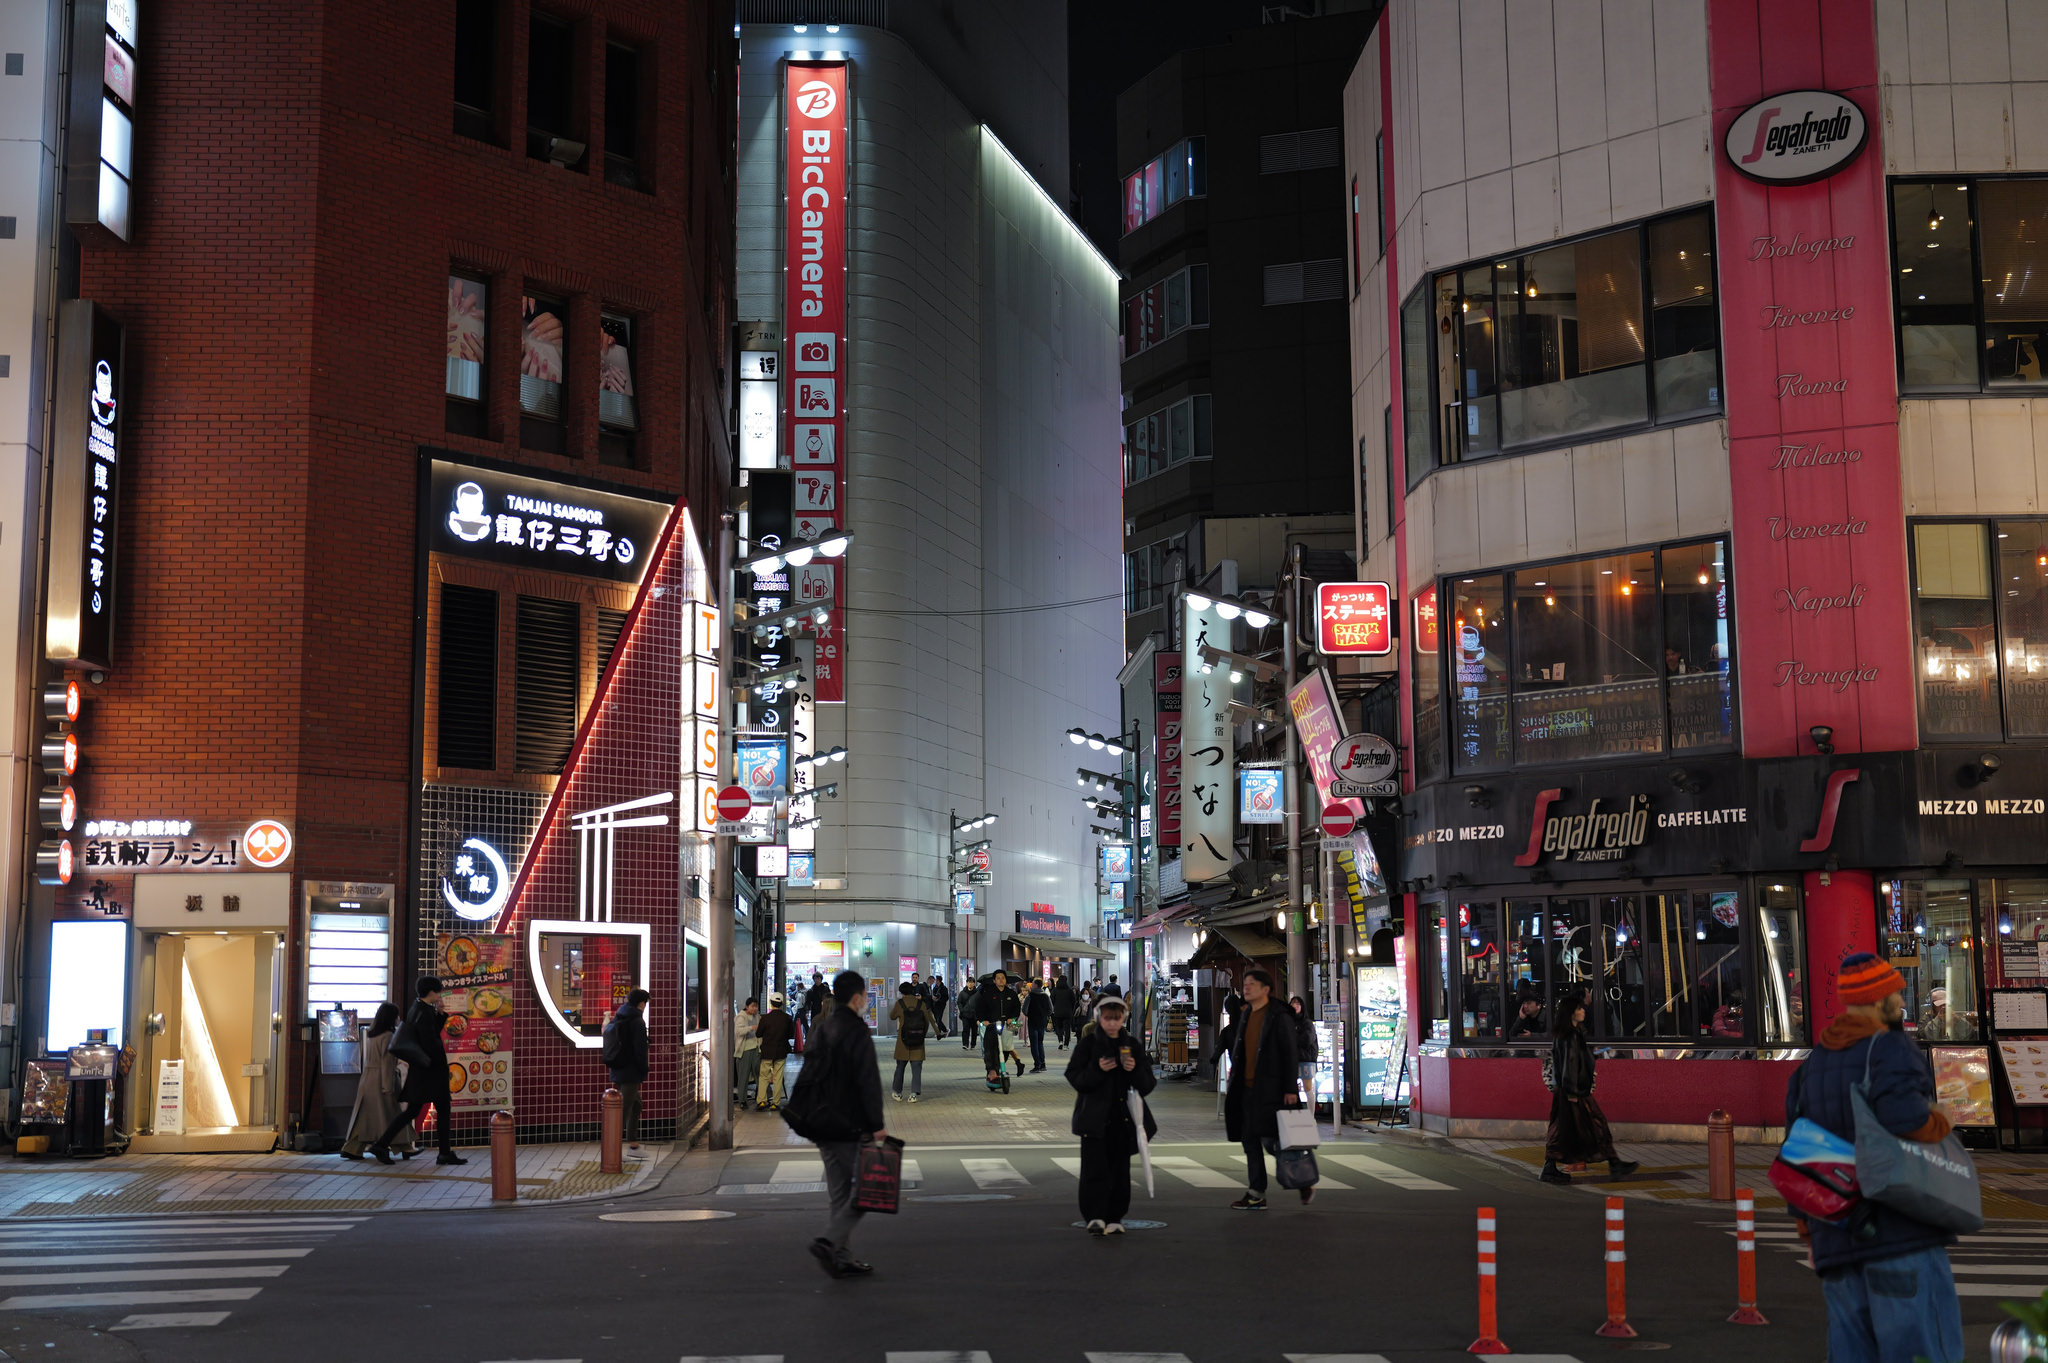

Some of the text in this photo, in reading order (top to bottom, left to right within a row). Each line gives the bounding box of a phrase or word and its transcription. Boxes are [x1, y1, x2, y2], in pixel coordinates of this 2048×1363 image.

[1741, 106, 1851, 164] Segafredo
[1793, 143, 1830, 155] ZANETTI
[802, 130, 830, 317] BicCamera
[1749, 233, 1855, 262] Bologna
[1760, 305, 1854, 330] Firenze
[758, 332, 775, 340] TRN
[1775, 373, 1847, 400] Roma
[1769, 442, 1862, 470] Milano
[506, 494, 552, 516] TAMJAI
[1767, 516, 1867, 541] Venezia
[1331, 593, 1375, 602] がっつり系
[1775, 583, 1867, 617] Napoli
[1323, 604, 1387, 621] ステーキ
[1336, 624, 1378, 634] STEAK
[1337, 634, 1367, 645] MAX
[1774, 661, 1878, 693] Perugia
[1214, 712, 1225, 737] 新宿
[743, 751, 760, 759] NO!
[1341, 745, 1391, 770] Segafredo
[1339, 783, 1393, 794] ESPRESSO
[1918, 799, 2046, 815] MEZZO MEZZO
[1460, 825, 1504, 840] MEZZO
[1513, 788, 1650, 867] Segafredo
[1577, 849, 1623, 861] ZANETTI
[1022, 916, 1070, 933] Aoyama Flower Market
[486, 965, 503, 974] No.1
[1922, 1149, 1971, 1179] EXPLORE
